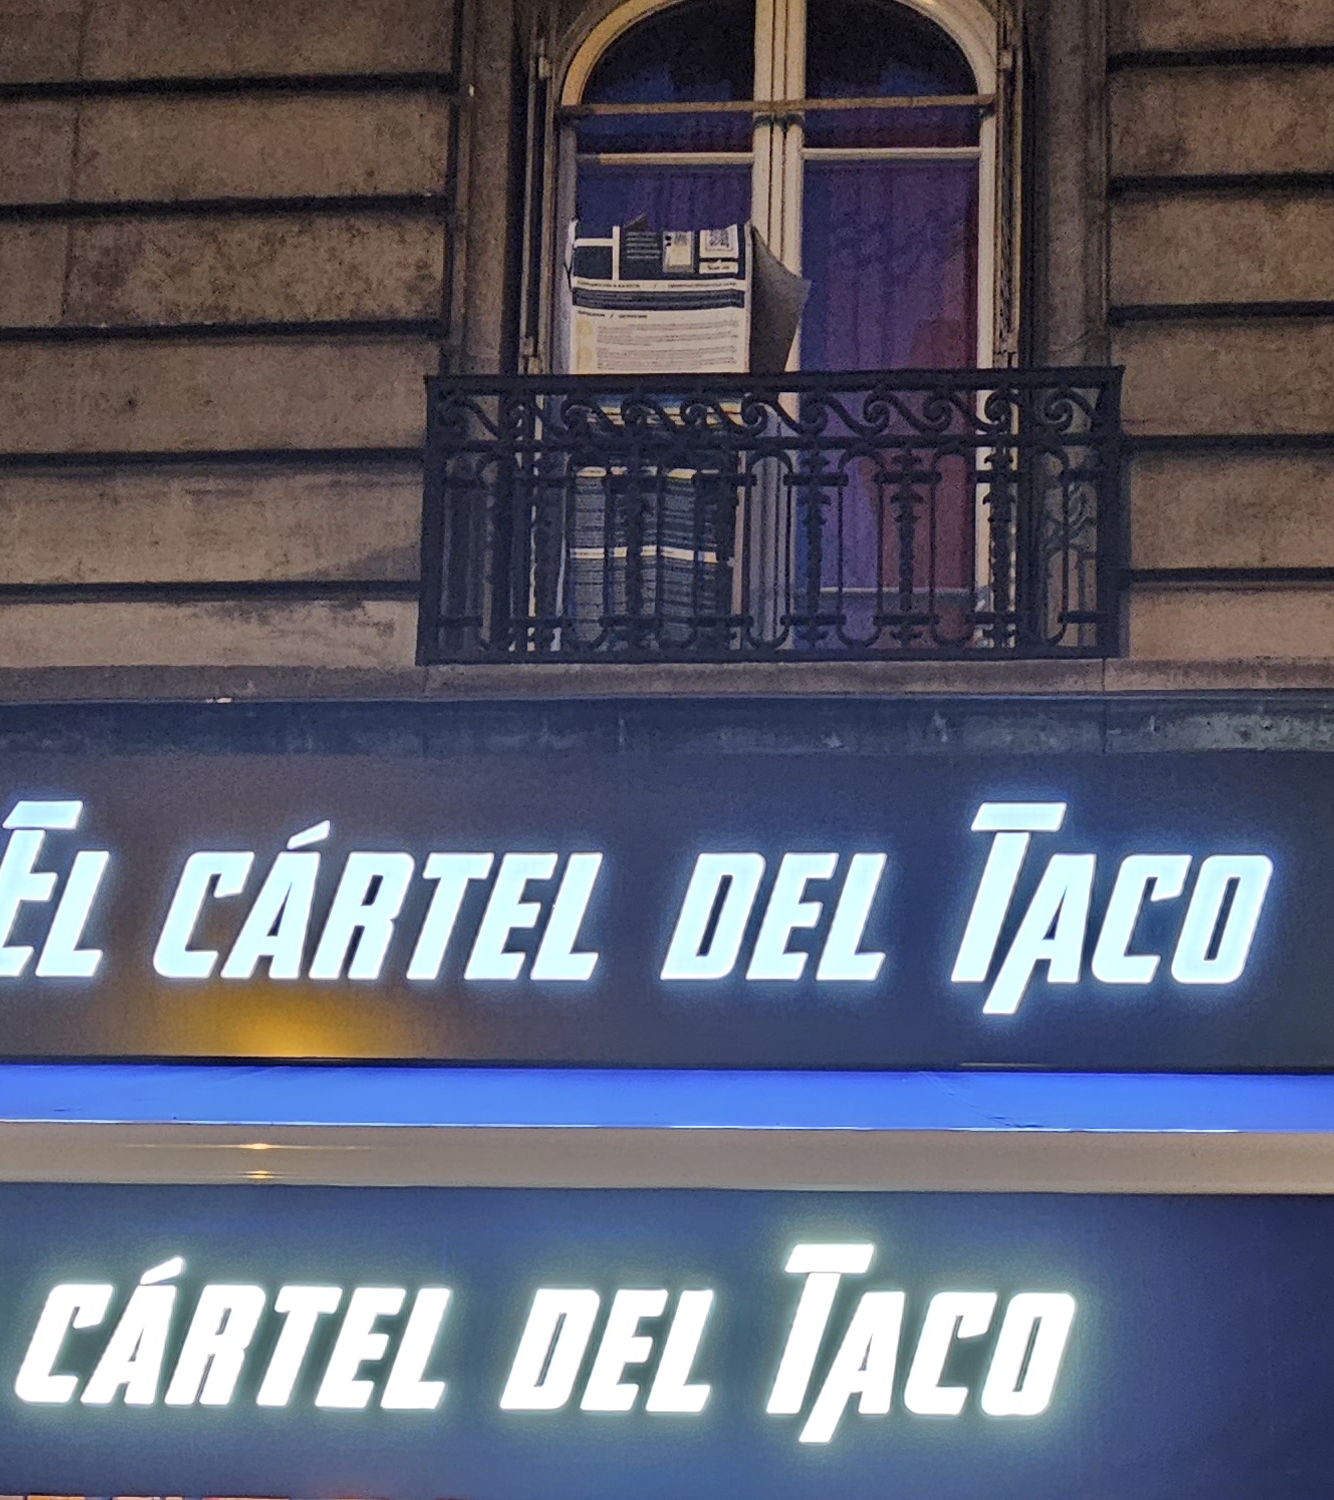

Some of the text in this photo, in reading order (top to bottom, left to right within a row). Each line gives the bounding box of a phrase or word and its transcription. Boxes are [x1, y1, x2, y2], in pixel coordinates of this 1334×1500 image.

[152, 820, 604, 981] CÁRTEL
[660, 851, 887, 983] DEL
[950, 801, 1274, 1015] TACO
[13, 1255, 453, 1412] CÁRTEL
[499, 1286, 715, 1415] DEL
[765, 1242, 1078, 1445] TACO
